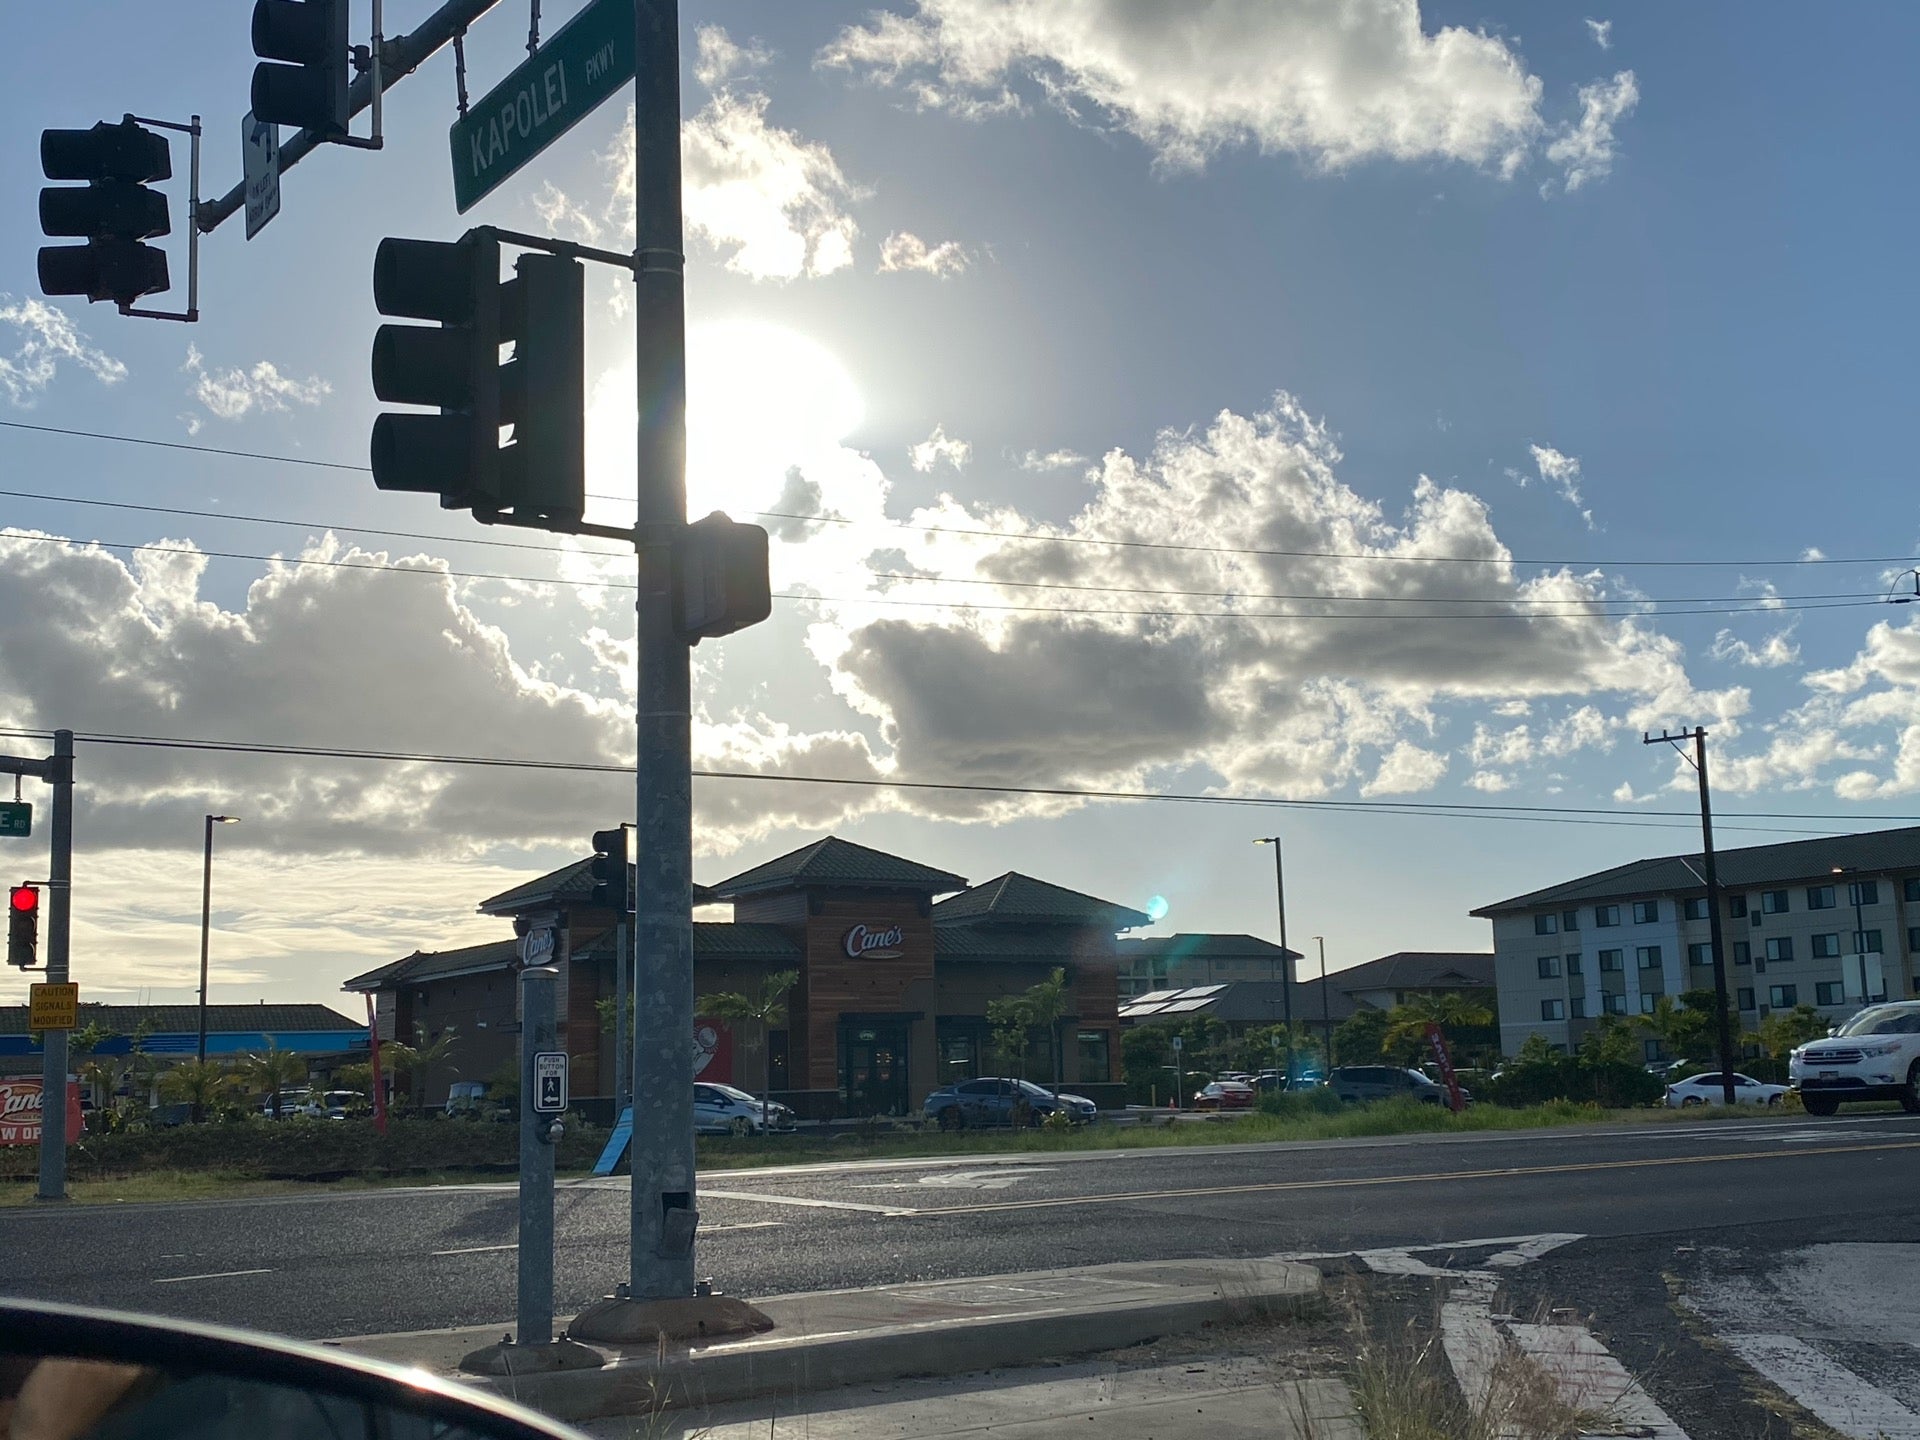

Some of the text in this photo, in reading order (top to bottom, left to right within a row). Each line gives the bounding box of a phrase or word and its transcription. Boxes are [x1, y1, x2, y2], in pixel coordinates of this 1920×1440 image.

[470, 39, 615, 177] KAPOLEI PKWY
[14, 819, 26, 829] RD
[847, 924, 902, 957] Cane's
[35, 986, 74, 997] CAUTION
[35, 1001, 72, 1011] SIGNALS
[33, 1015, 73, 1025] MODIFIED
